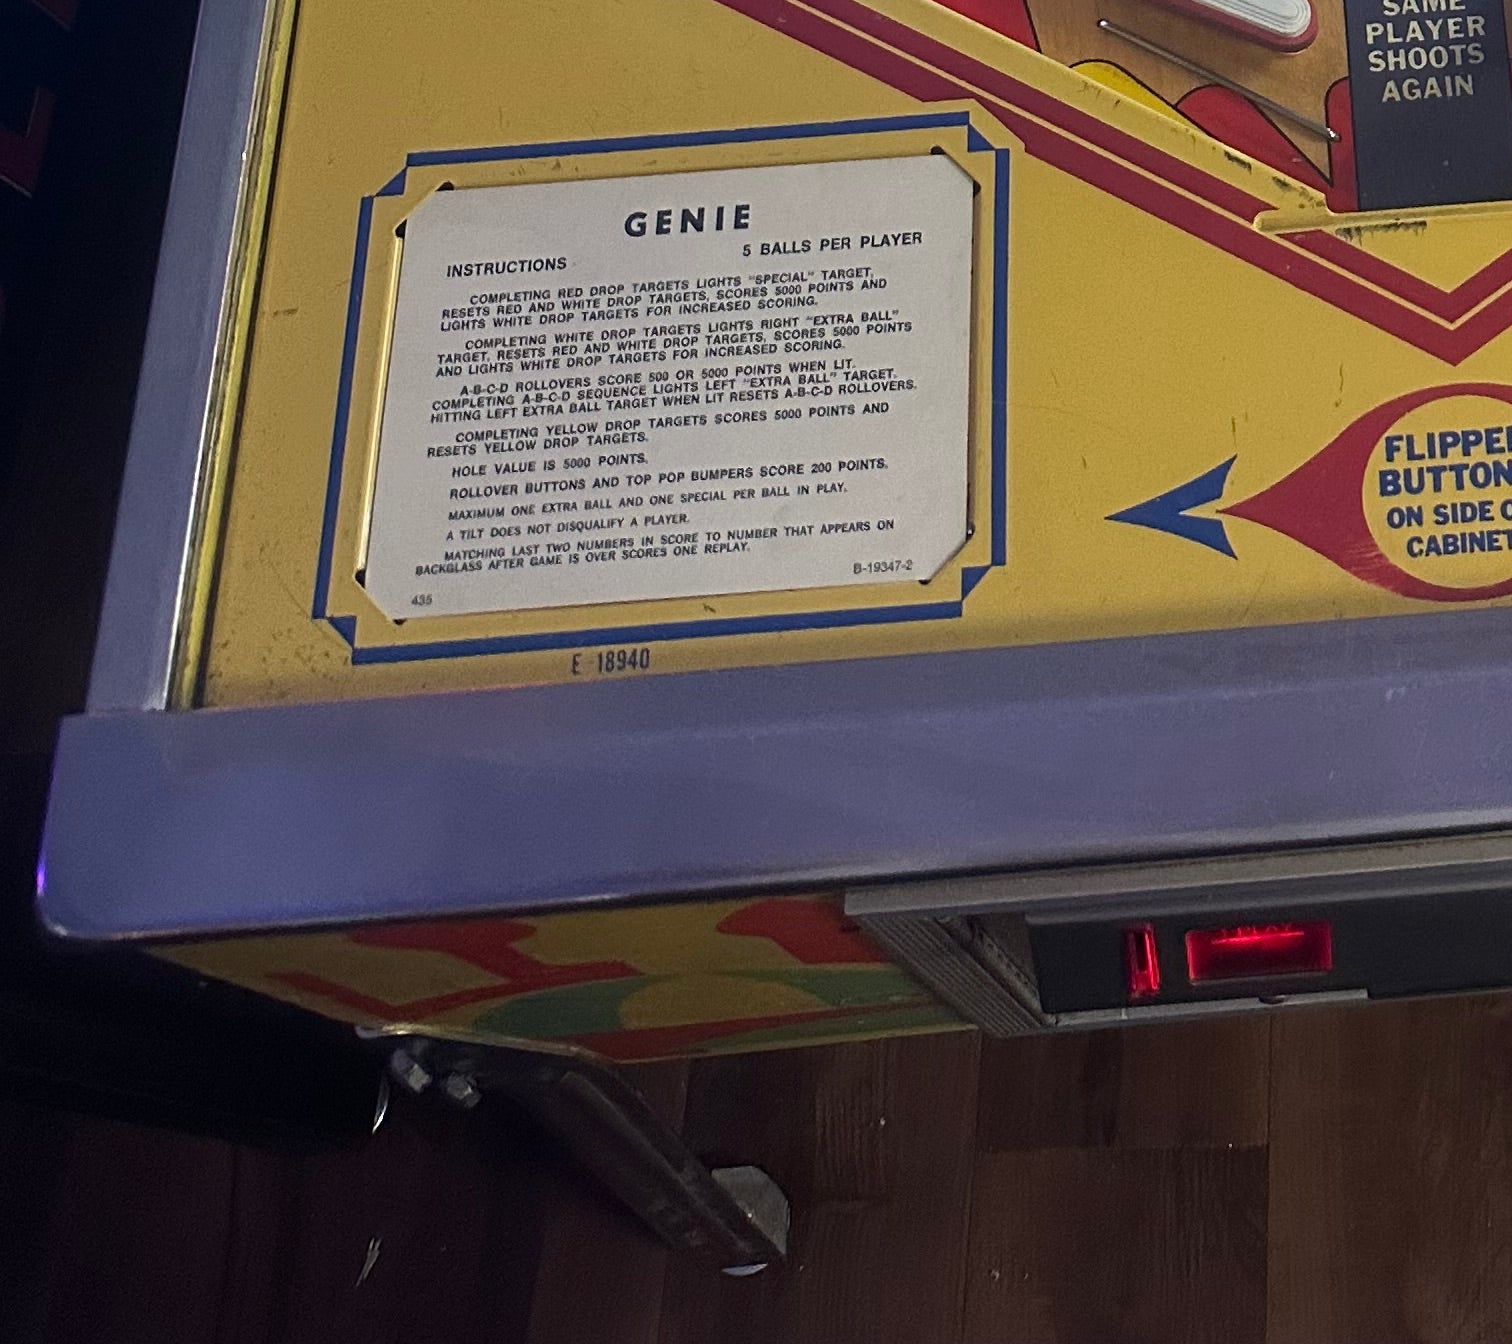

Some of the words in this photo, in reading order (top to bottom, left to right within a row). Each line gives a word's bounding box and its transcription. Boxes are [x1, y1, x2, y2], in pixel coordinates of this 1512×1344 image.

[1365, 15, 1487, 44] PLAYER
[1366, 42, 1485, 72] SHOOTS
[1381, 73, 1476, 104] AGAIN
[624, 203, 752, 237] GENIE
[742, 243, 752, 258] 5
[760, 238, 812, 256] BALLS
[819, 235, 853, 253] PER
[860, 231, 923, 250] PLAYER
[446, 256, 567, 279] INSTRUCTIONS
[451, 464, 488, 479] HOLE
[493, 460, 537, 476] VALUE
[542, 459, 556, 473] IS
[562, 456, 591, 470] 5000
[597, 452, 649, 467] POINTS.
[1387, 505, 1424, 528] ON
[1433, 500, 1494, 525] SIDE
[571, 653, 582, 675] E
[596, 647, 651, 674] 18940
